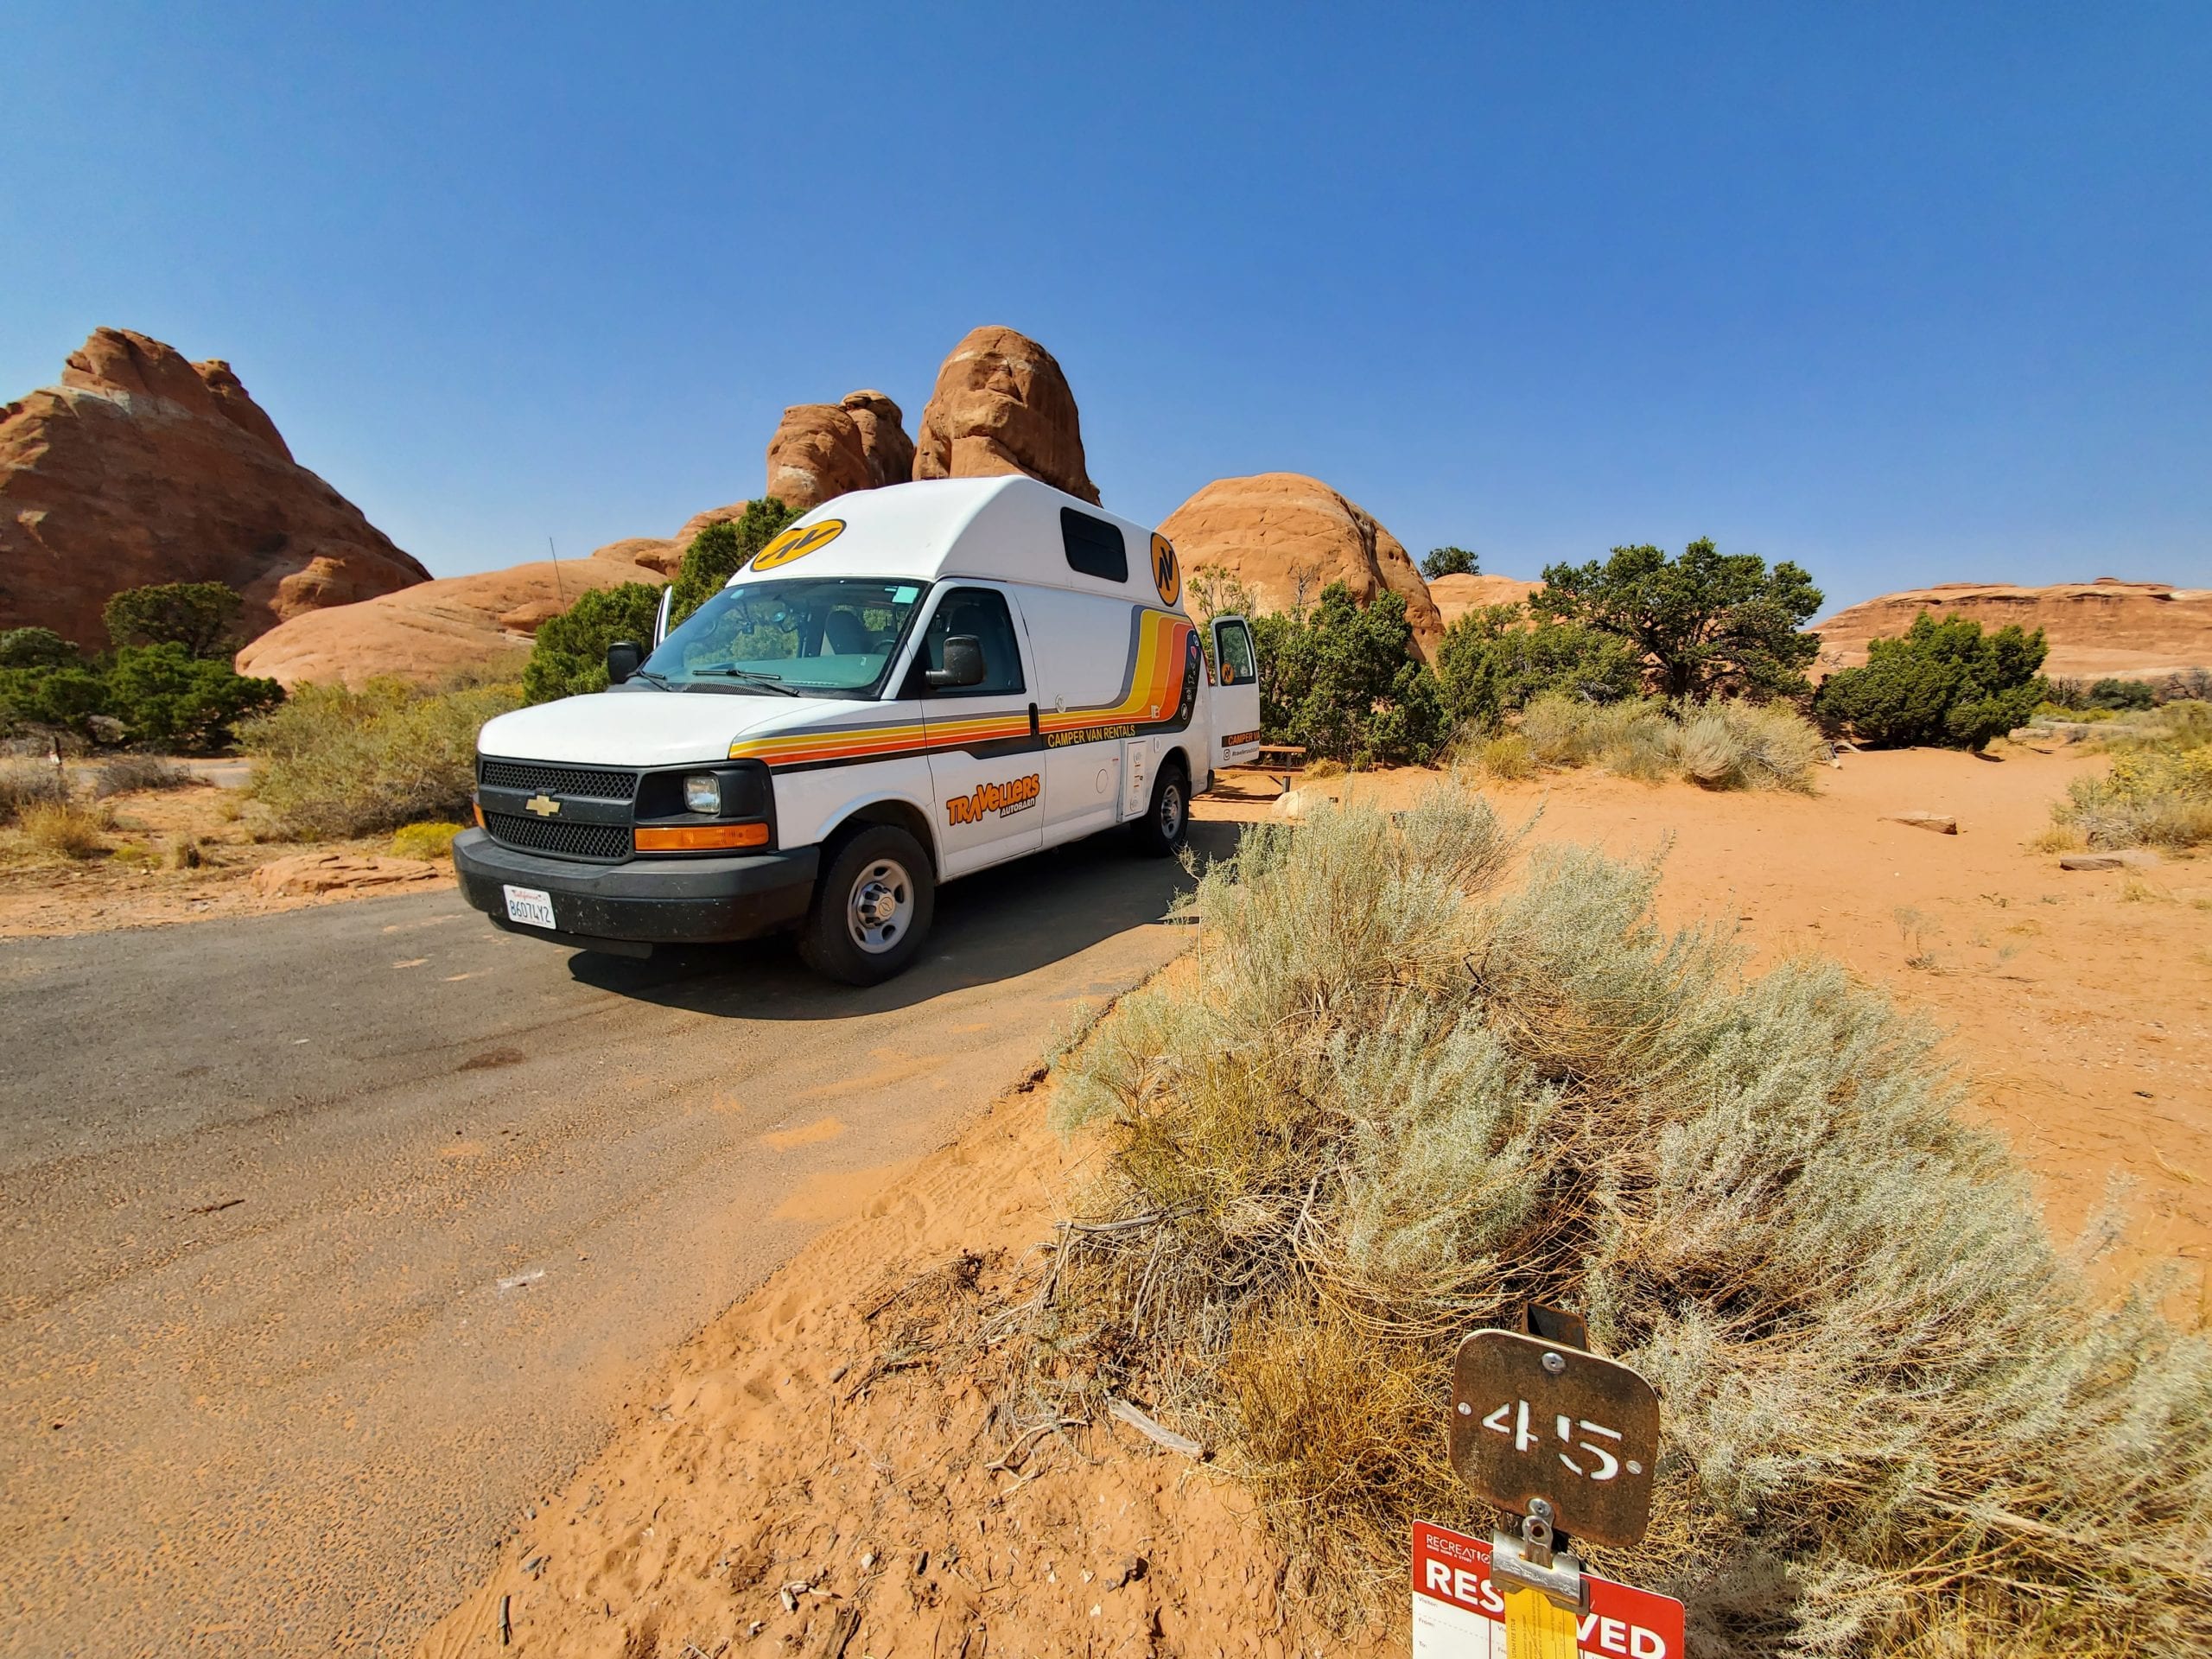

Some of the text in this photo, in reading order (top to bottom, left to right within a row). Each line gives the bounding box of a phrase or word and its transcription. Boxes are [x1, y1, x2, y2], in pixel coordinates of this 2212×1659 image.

[1047, 724, 1135, 747] CAMPER VAN RENTALS
[1228, 732, 1253, 746] CAMPER
[1482, 1398, 1623, 1481] 45
[1426, 1534, 1491, 1565] RECREATIO
[1427, 1558, 1667, 1659] RESVED
